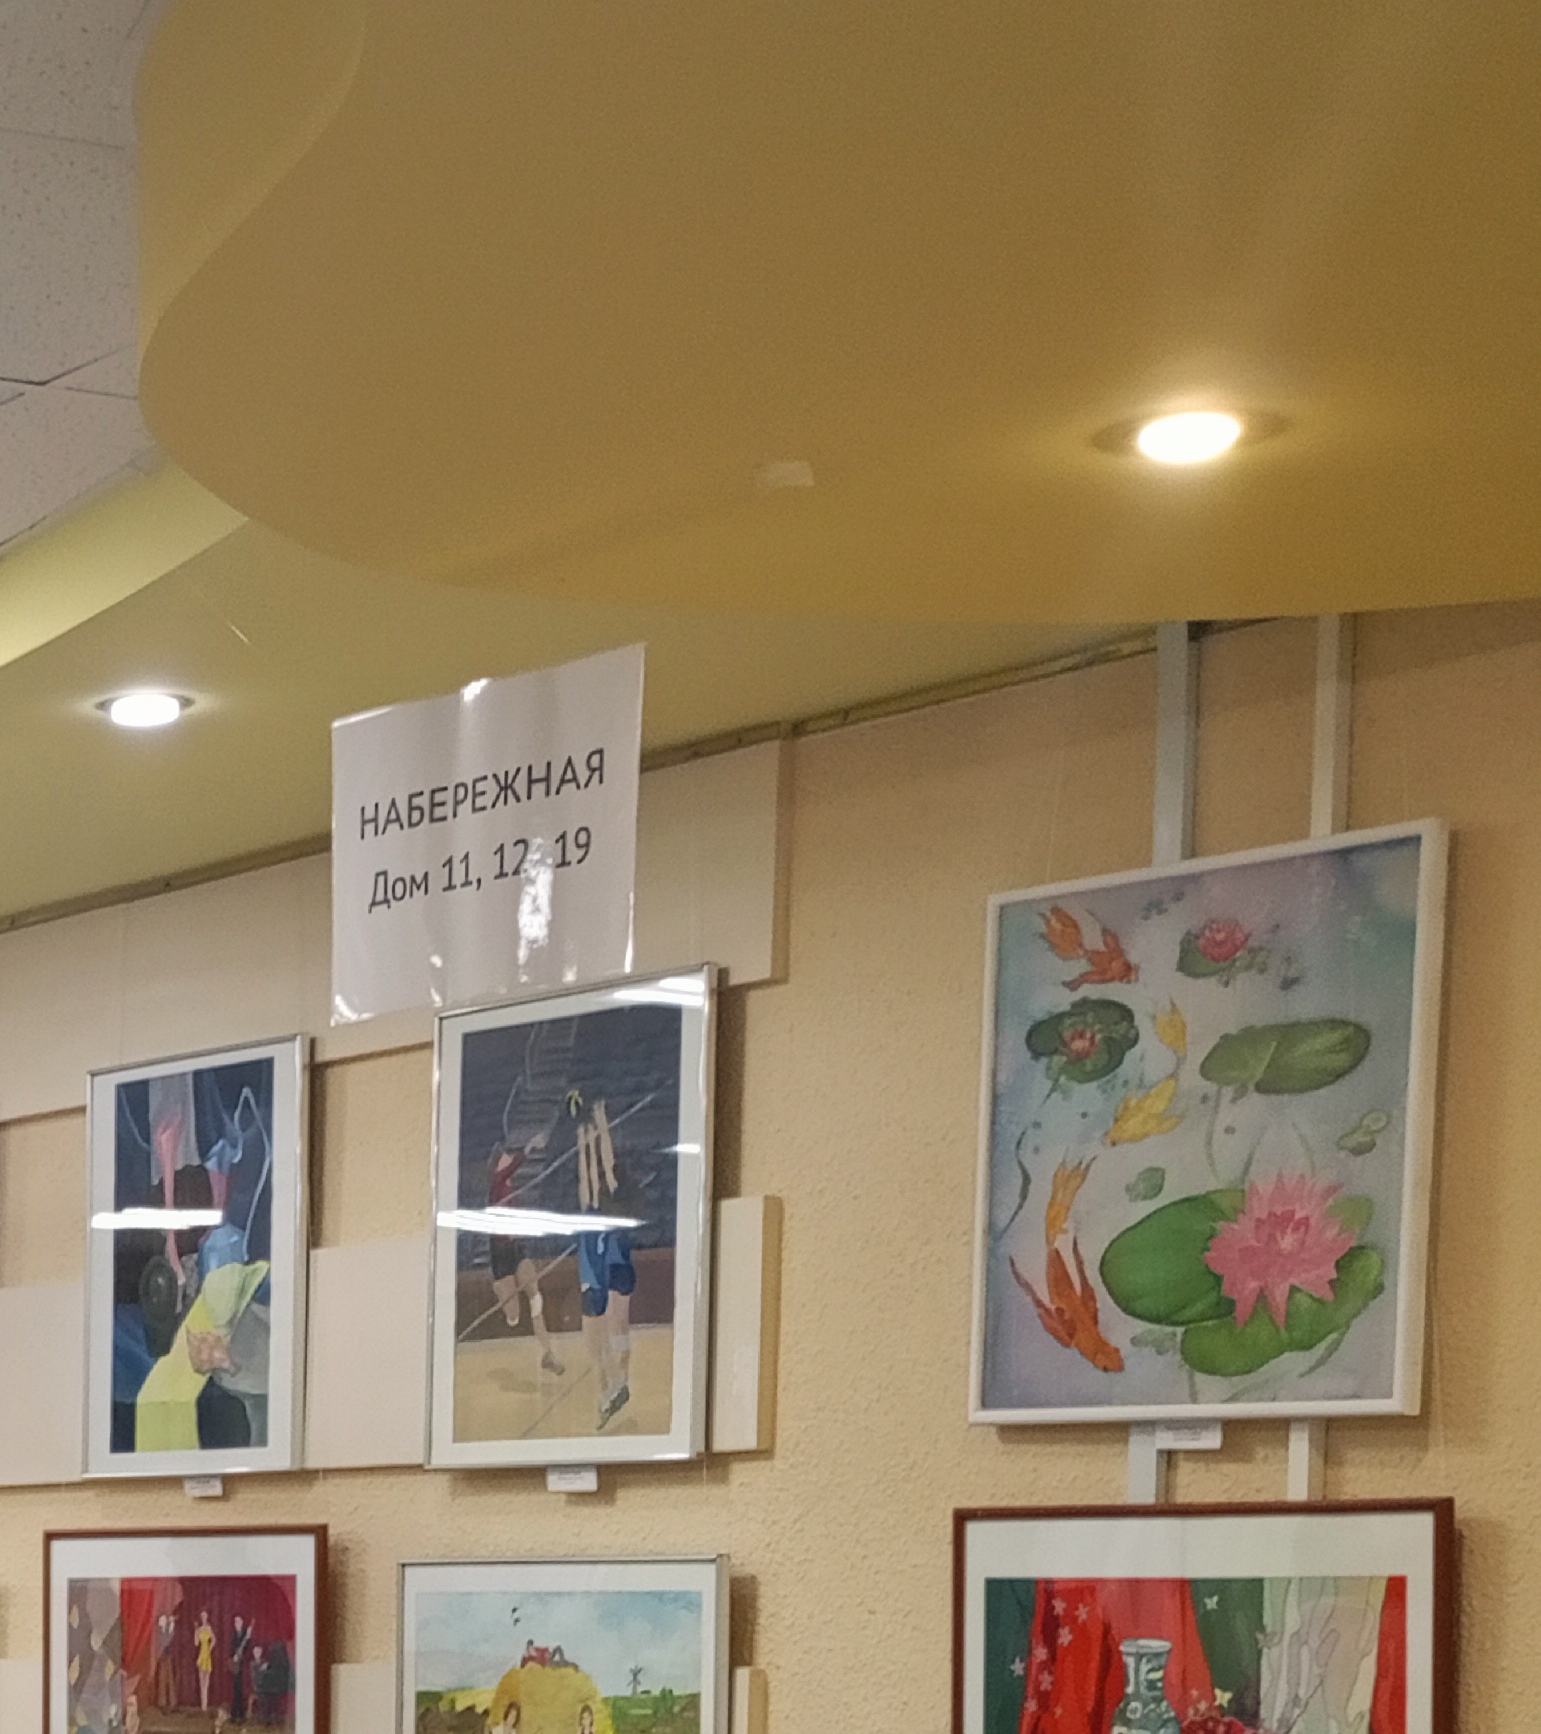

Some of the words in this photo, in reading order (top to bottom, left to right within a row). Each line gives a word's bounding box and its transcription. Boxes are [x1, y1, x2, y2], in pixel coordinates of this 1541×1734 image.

[359, 747, 605, 841] НАБЕРЕЖНАЯ
[368, 869, 429, 914] Дом
[441, 851, 482, 893] 11,
[493, 838, 537, 880] 12
[554, 826, 592, 868] 19
